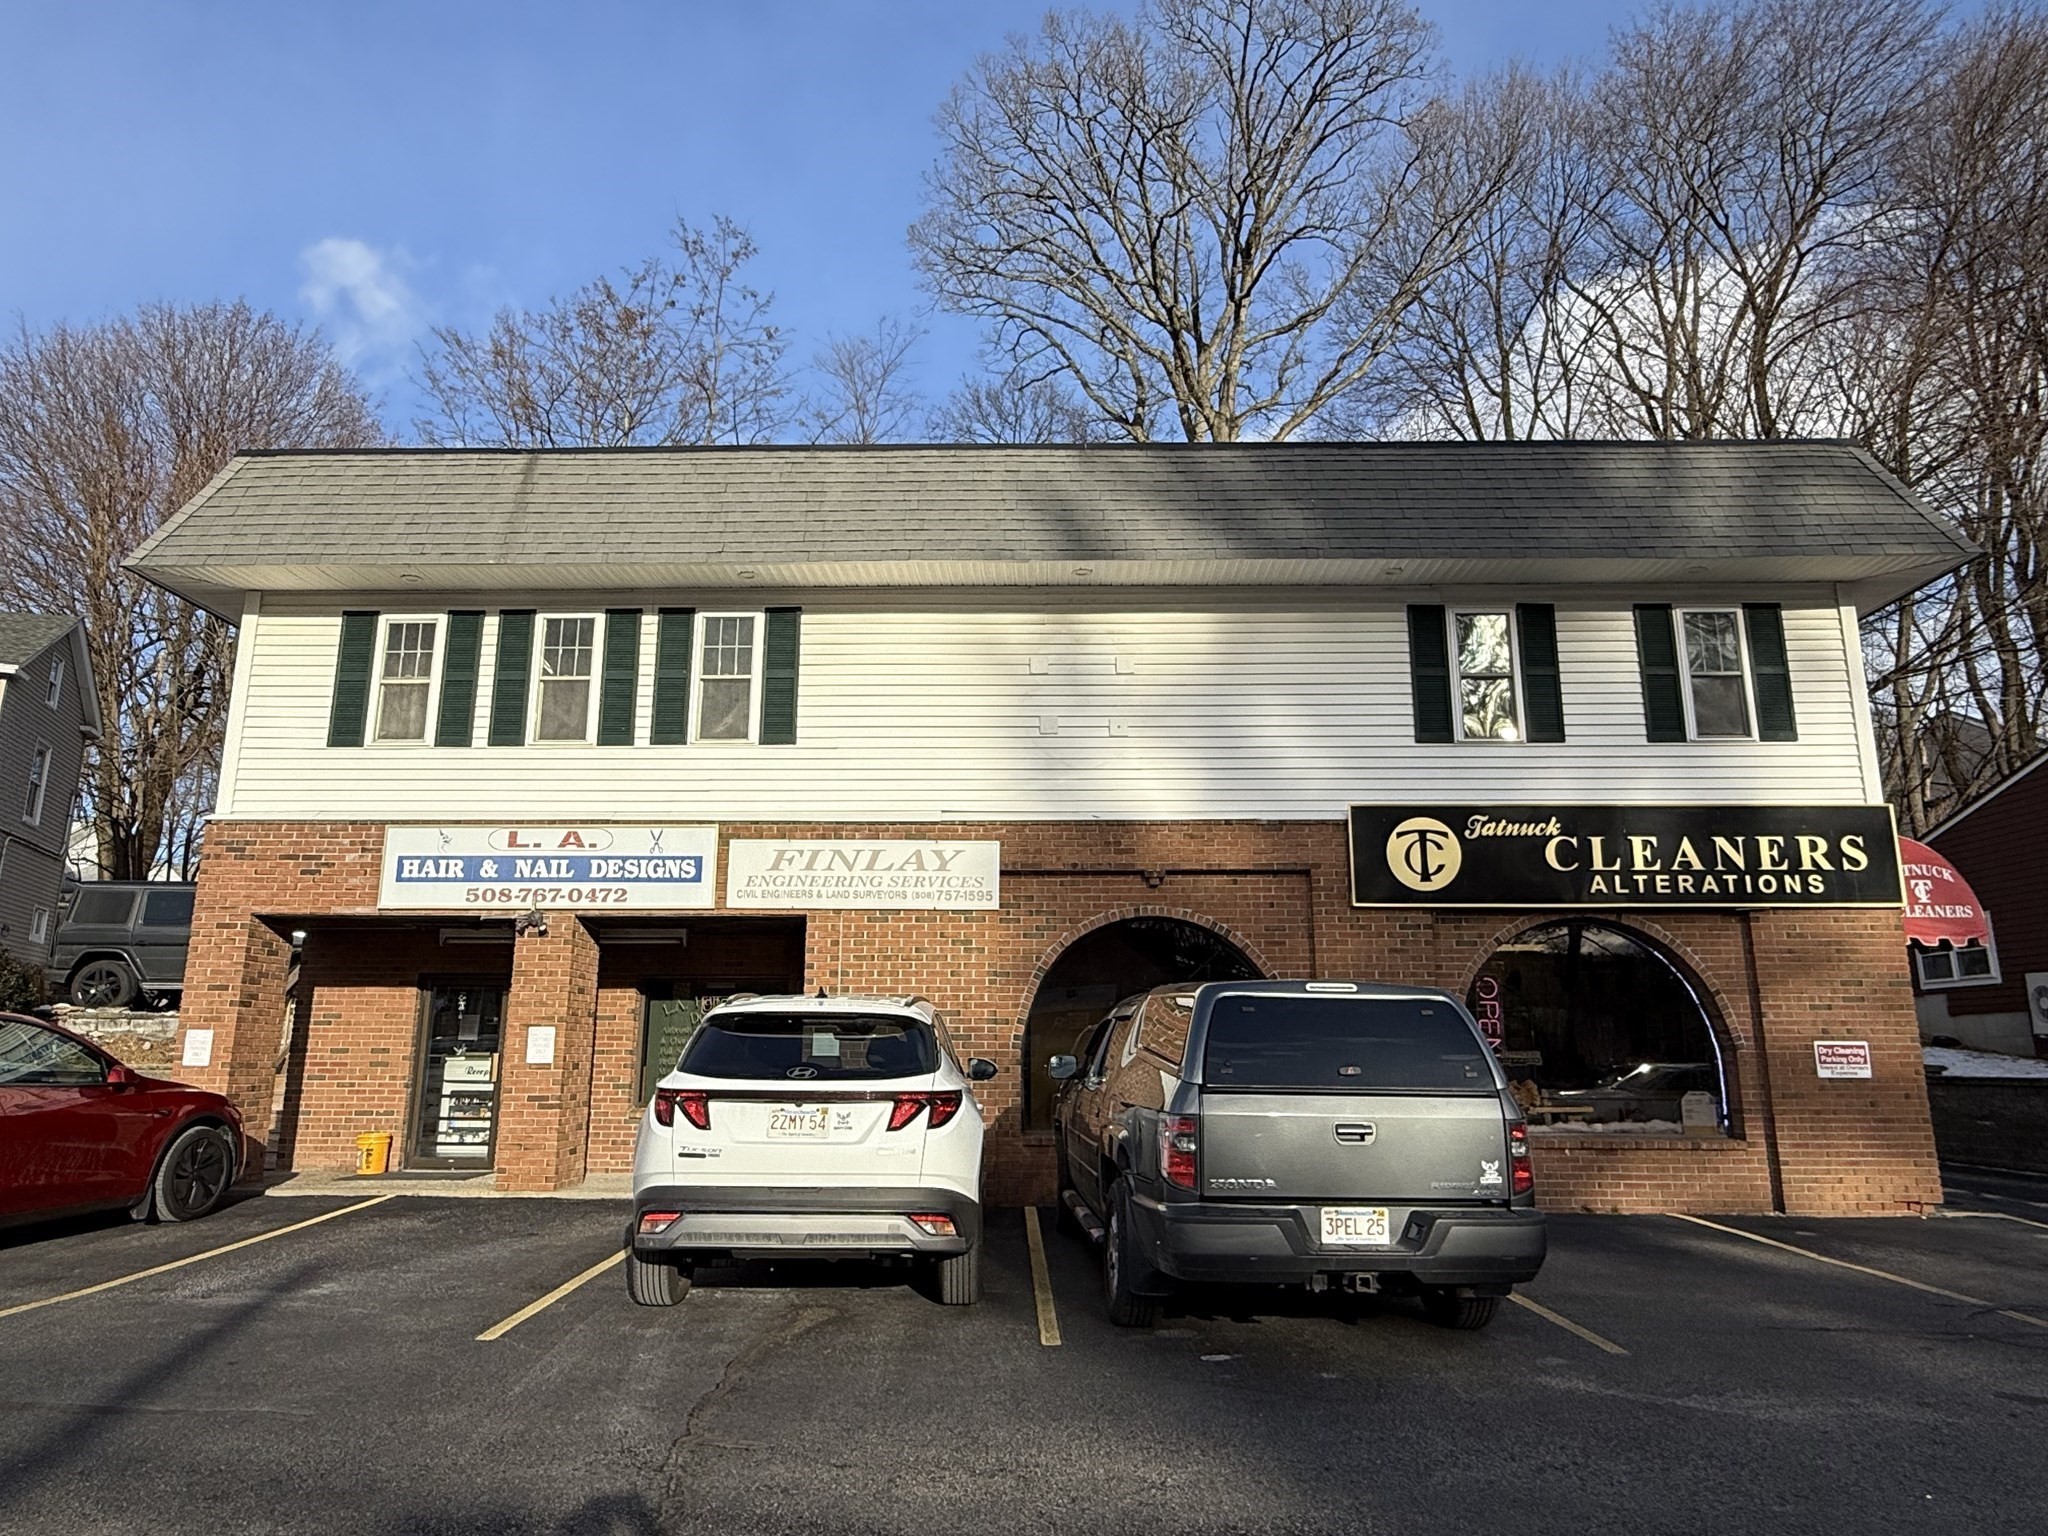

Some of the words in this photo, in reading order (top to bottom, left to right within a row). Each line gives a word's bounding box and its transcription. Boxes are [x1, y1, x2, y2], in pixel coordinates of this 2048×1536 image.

[1464, 815, 1562, 840] Tatnuck
[508, 831, 542, 848] L.
[557, 831, 598, 848] A.
[766, 849, 966, 872] FINLAY
[1545, 835, 1869, 872] CLEANERS
[401, 859, 464, 878] HAIR
[479, 859, 498, 878] &
[514, 859, 575, 878] NAIL
[589, 859, 697, 878] DESIGNS
[745, 875, 883, 888] ENGINEERING
[887, 875, 985, 888] SERVICES
[1590, 874, 1826, 894] ALTERATIONS
[465, 888, 628, 903] 508-767-0472
[736, 889, 758, 899] CIVIL
[761, 889, 813, 899] ENGINEERS
[816, 889, 823, 899] &
[826, 890, 850, 899] LAND
[852, 890, 908, 899] SURVEYORS
[1818, 1046, 1832, 1056] Dry
[1821, 1055, 1847, 1064] Parking
[770, 1114, 806, 1130] 2ZMY
[809, 1114, 826, 1130] 54
[1208, 1178, 1279, 1190] HONDA
[1325, 1217, 1363, 1236] 3PEL
[1366, 1218, 1385, 1236] 25
